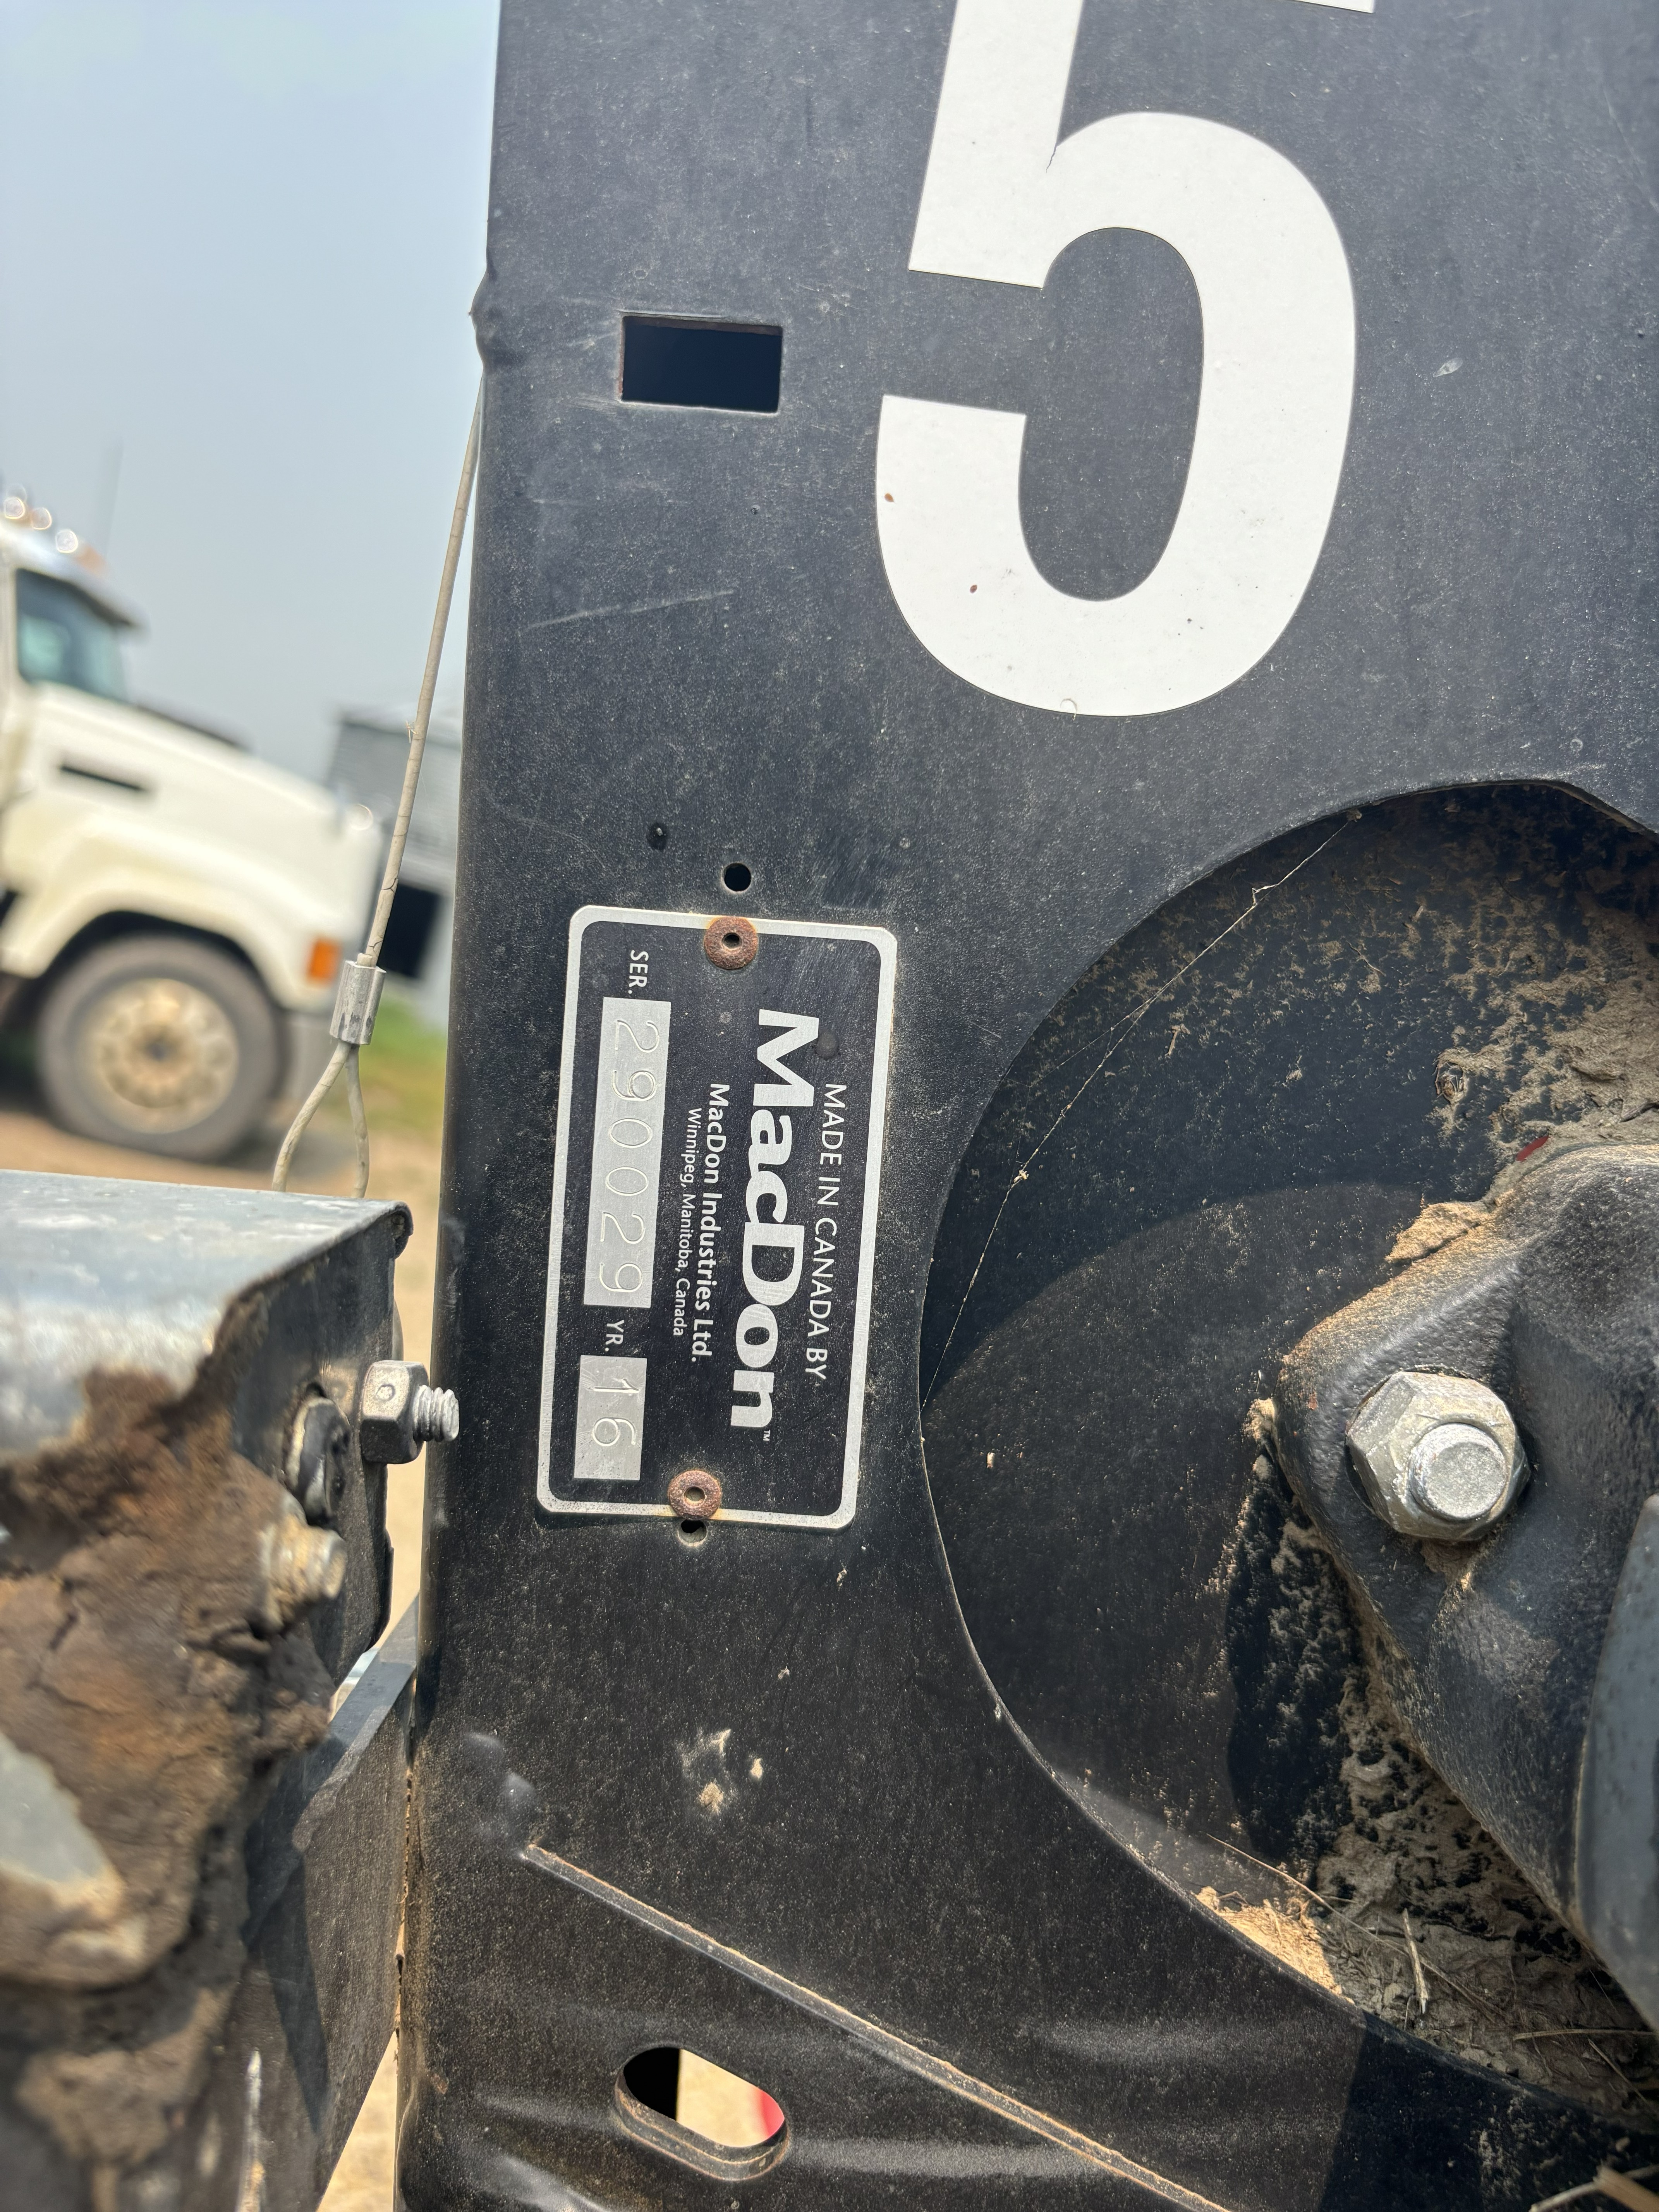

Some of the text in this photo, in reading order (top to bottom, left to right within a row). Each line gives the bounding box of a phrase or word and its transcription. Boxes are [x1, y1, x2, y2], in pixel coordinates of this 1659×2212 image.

[875, 0, 1374, 717] 5
[592, 950, 660, 1447] SER. 290029 YR. 16
[673, 1108, 702, 1336] Winnipeg, Manitoba, Canada
[691, 1084, 730, 1362] MacDon Industries Ltd.
[731, 1008, 819, 1428] MacDon
[805, 1084, 847, 1380] MADE IN CANADA BY
